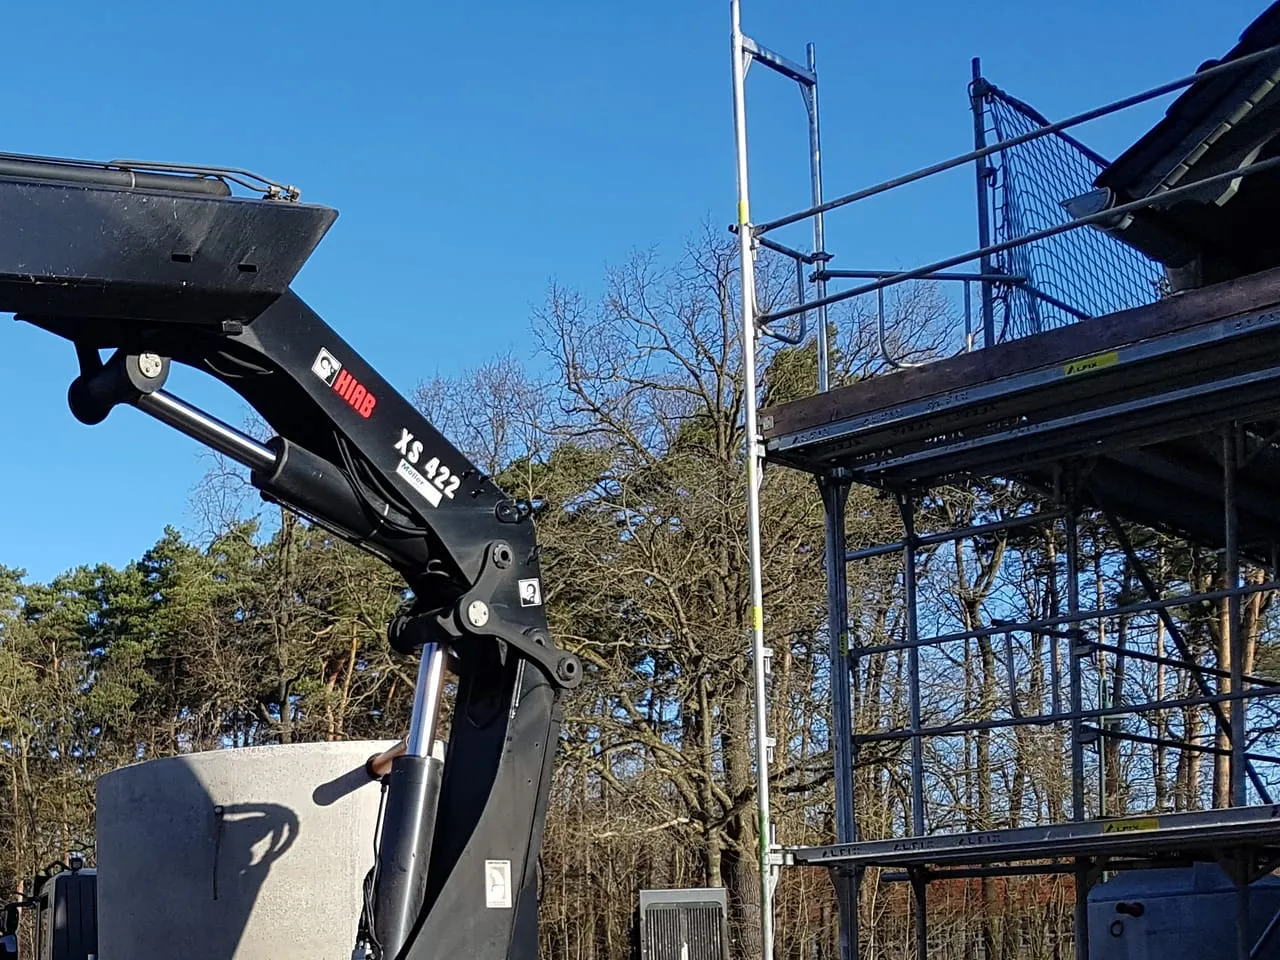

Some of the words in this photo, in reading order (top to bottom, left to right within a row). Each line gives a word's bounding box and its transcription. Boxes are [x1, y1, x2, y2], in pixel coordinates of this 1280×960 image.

[333, 368, 376, 418] HIAB
[394, 427, 424, 463] XS
[425, 457, 461, 499] 422
